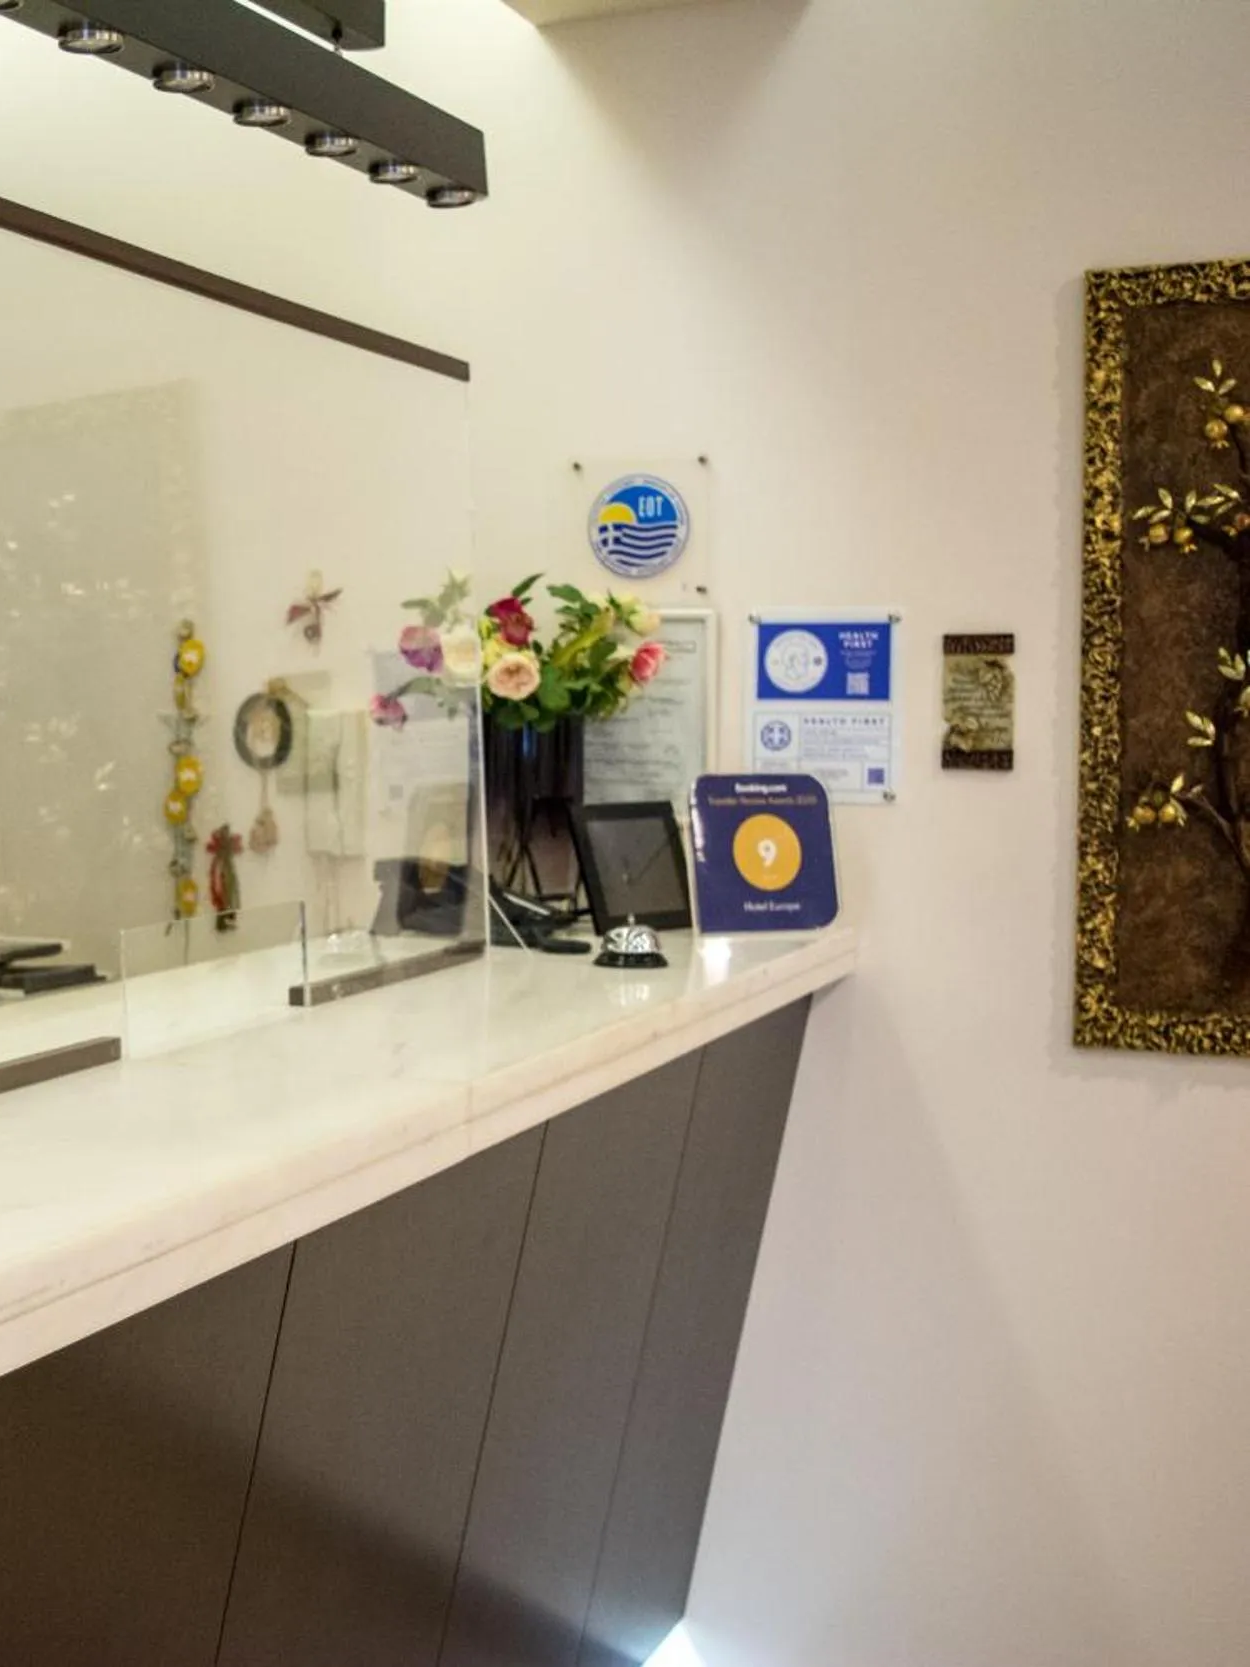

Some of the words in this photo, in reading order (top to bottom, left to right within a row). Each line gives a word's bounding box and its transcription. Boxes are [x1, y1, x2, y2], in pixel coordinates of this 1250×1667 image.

[757, 838, 778, 868] 9
[743, 901, 768, 911] Hotel
[769, 901, 801, 913] Europe
